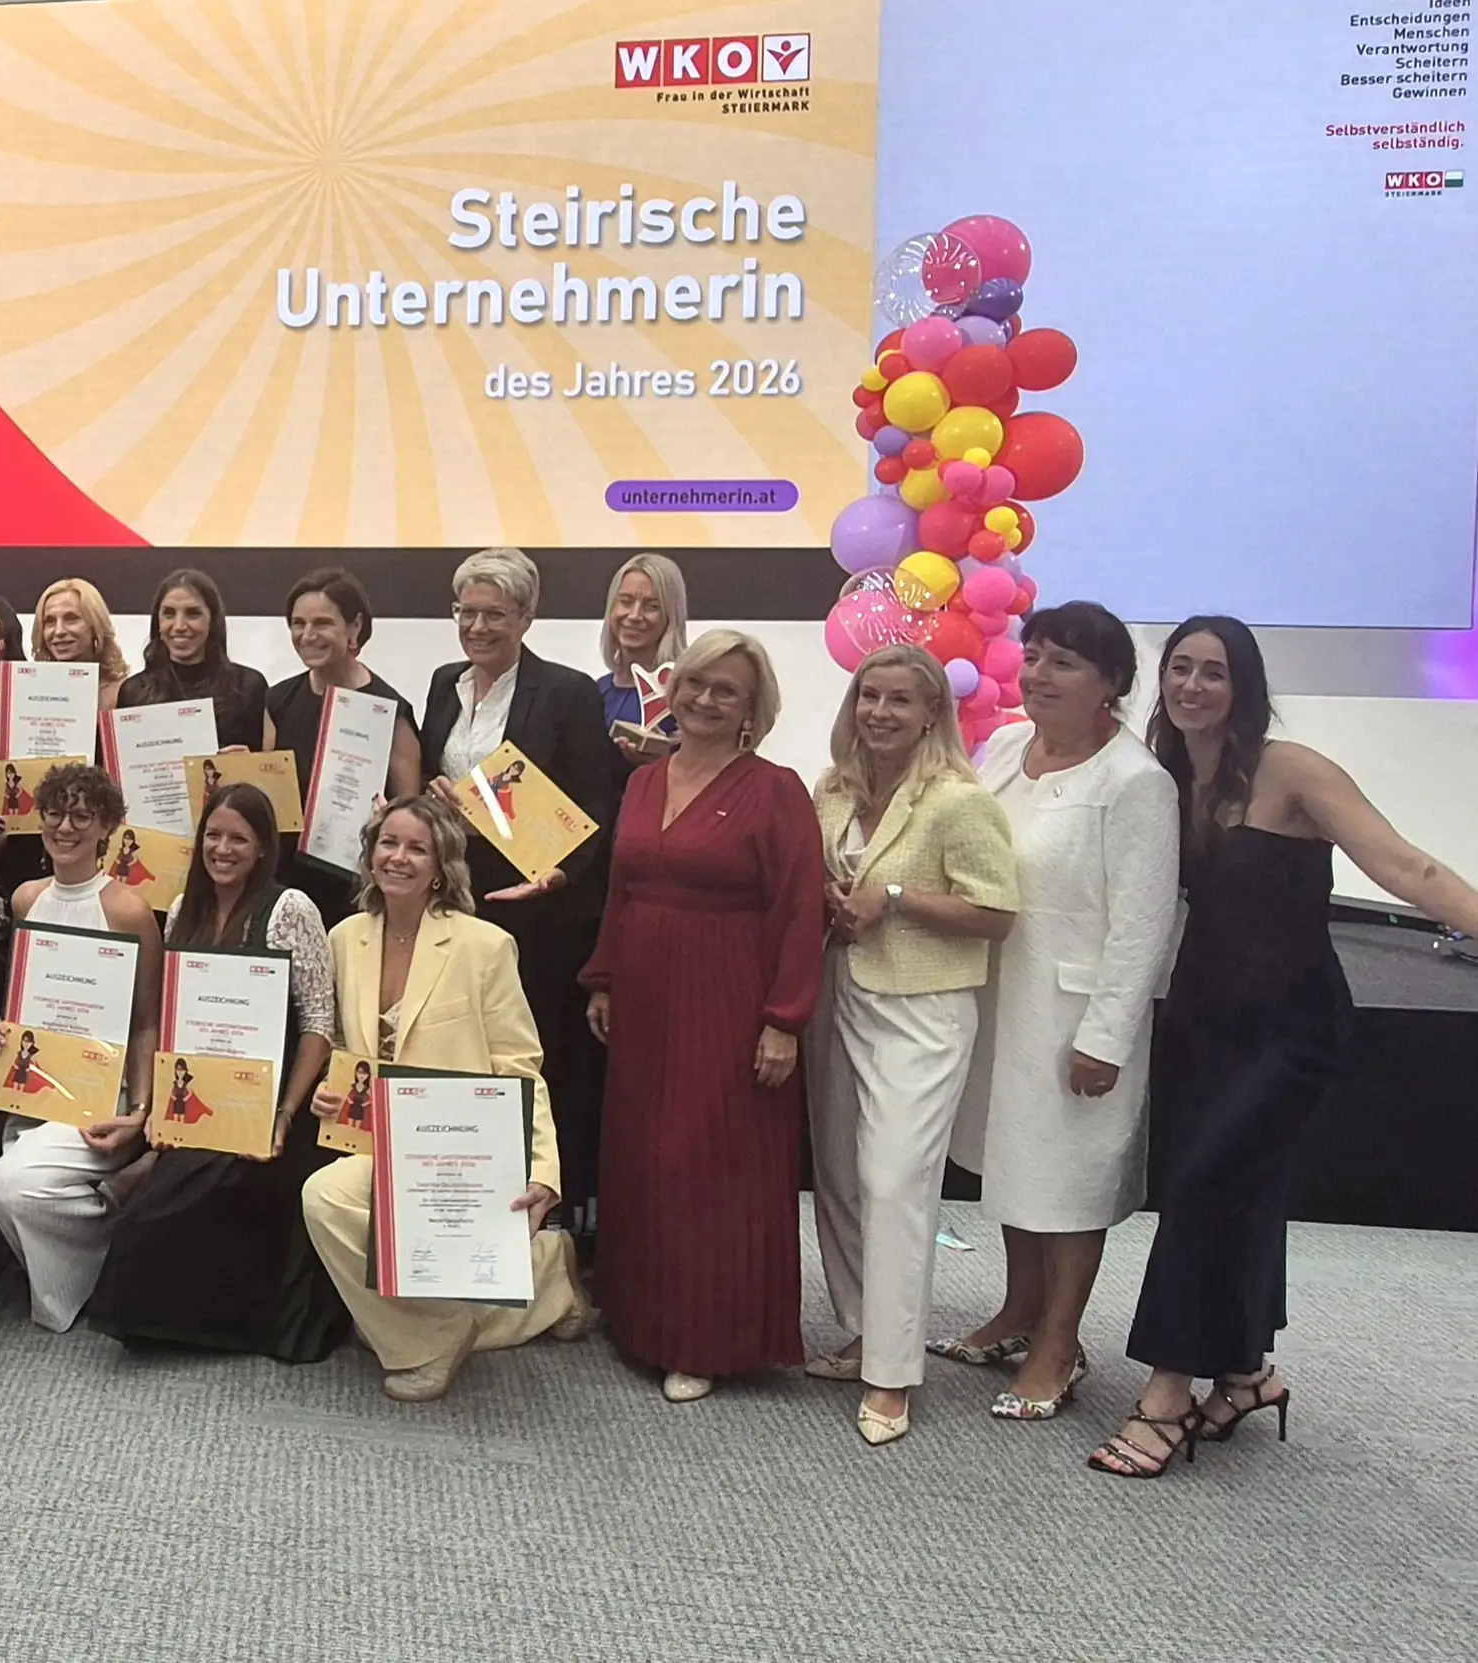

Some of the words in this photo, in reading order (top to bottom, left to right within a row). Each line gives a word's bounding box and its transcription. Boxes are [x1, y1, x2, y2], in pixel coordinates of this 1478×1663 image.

[1350, 12, 1471, 26] Entscheidungen
[1394, 27, 1470, 40] Menschen
[1356, 41, 1469, 55] Verantwortung
[618, 41, 753, 81] WKO
[1395, 57, 1468, 69] Scheitern
[1340, 74, 1392, 86] Besser
[1396, 72, 1467, 84] scheitern
[657, 92, 687, 103] Frau
[693, 91, 704, 101] in
[710, 90, 733, 100] der
[738, 87, 809, 99] Wirtschaft
[1392, 87, 1466, 99] Gewinnen
[722, 101, 809, 114] STEIERMARK
[1325, 121, 1465, 136] Selbstverständlich
[1372, 136, 1464, 150] selbständig.
[1386, 173, 1441, 188] WKO
[448, 180, 806, 248] Steirische
[276, 258, 803, 328] Unternehmerin
[484, 363, 552, 399] des
[563, 361, 695, 397] Jahres
[709, 359, 801, 395] 2026
[621, 487, 776, 506] unternehmerin.at
